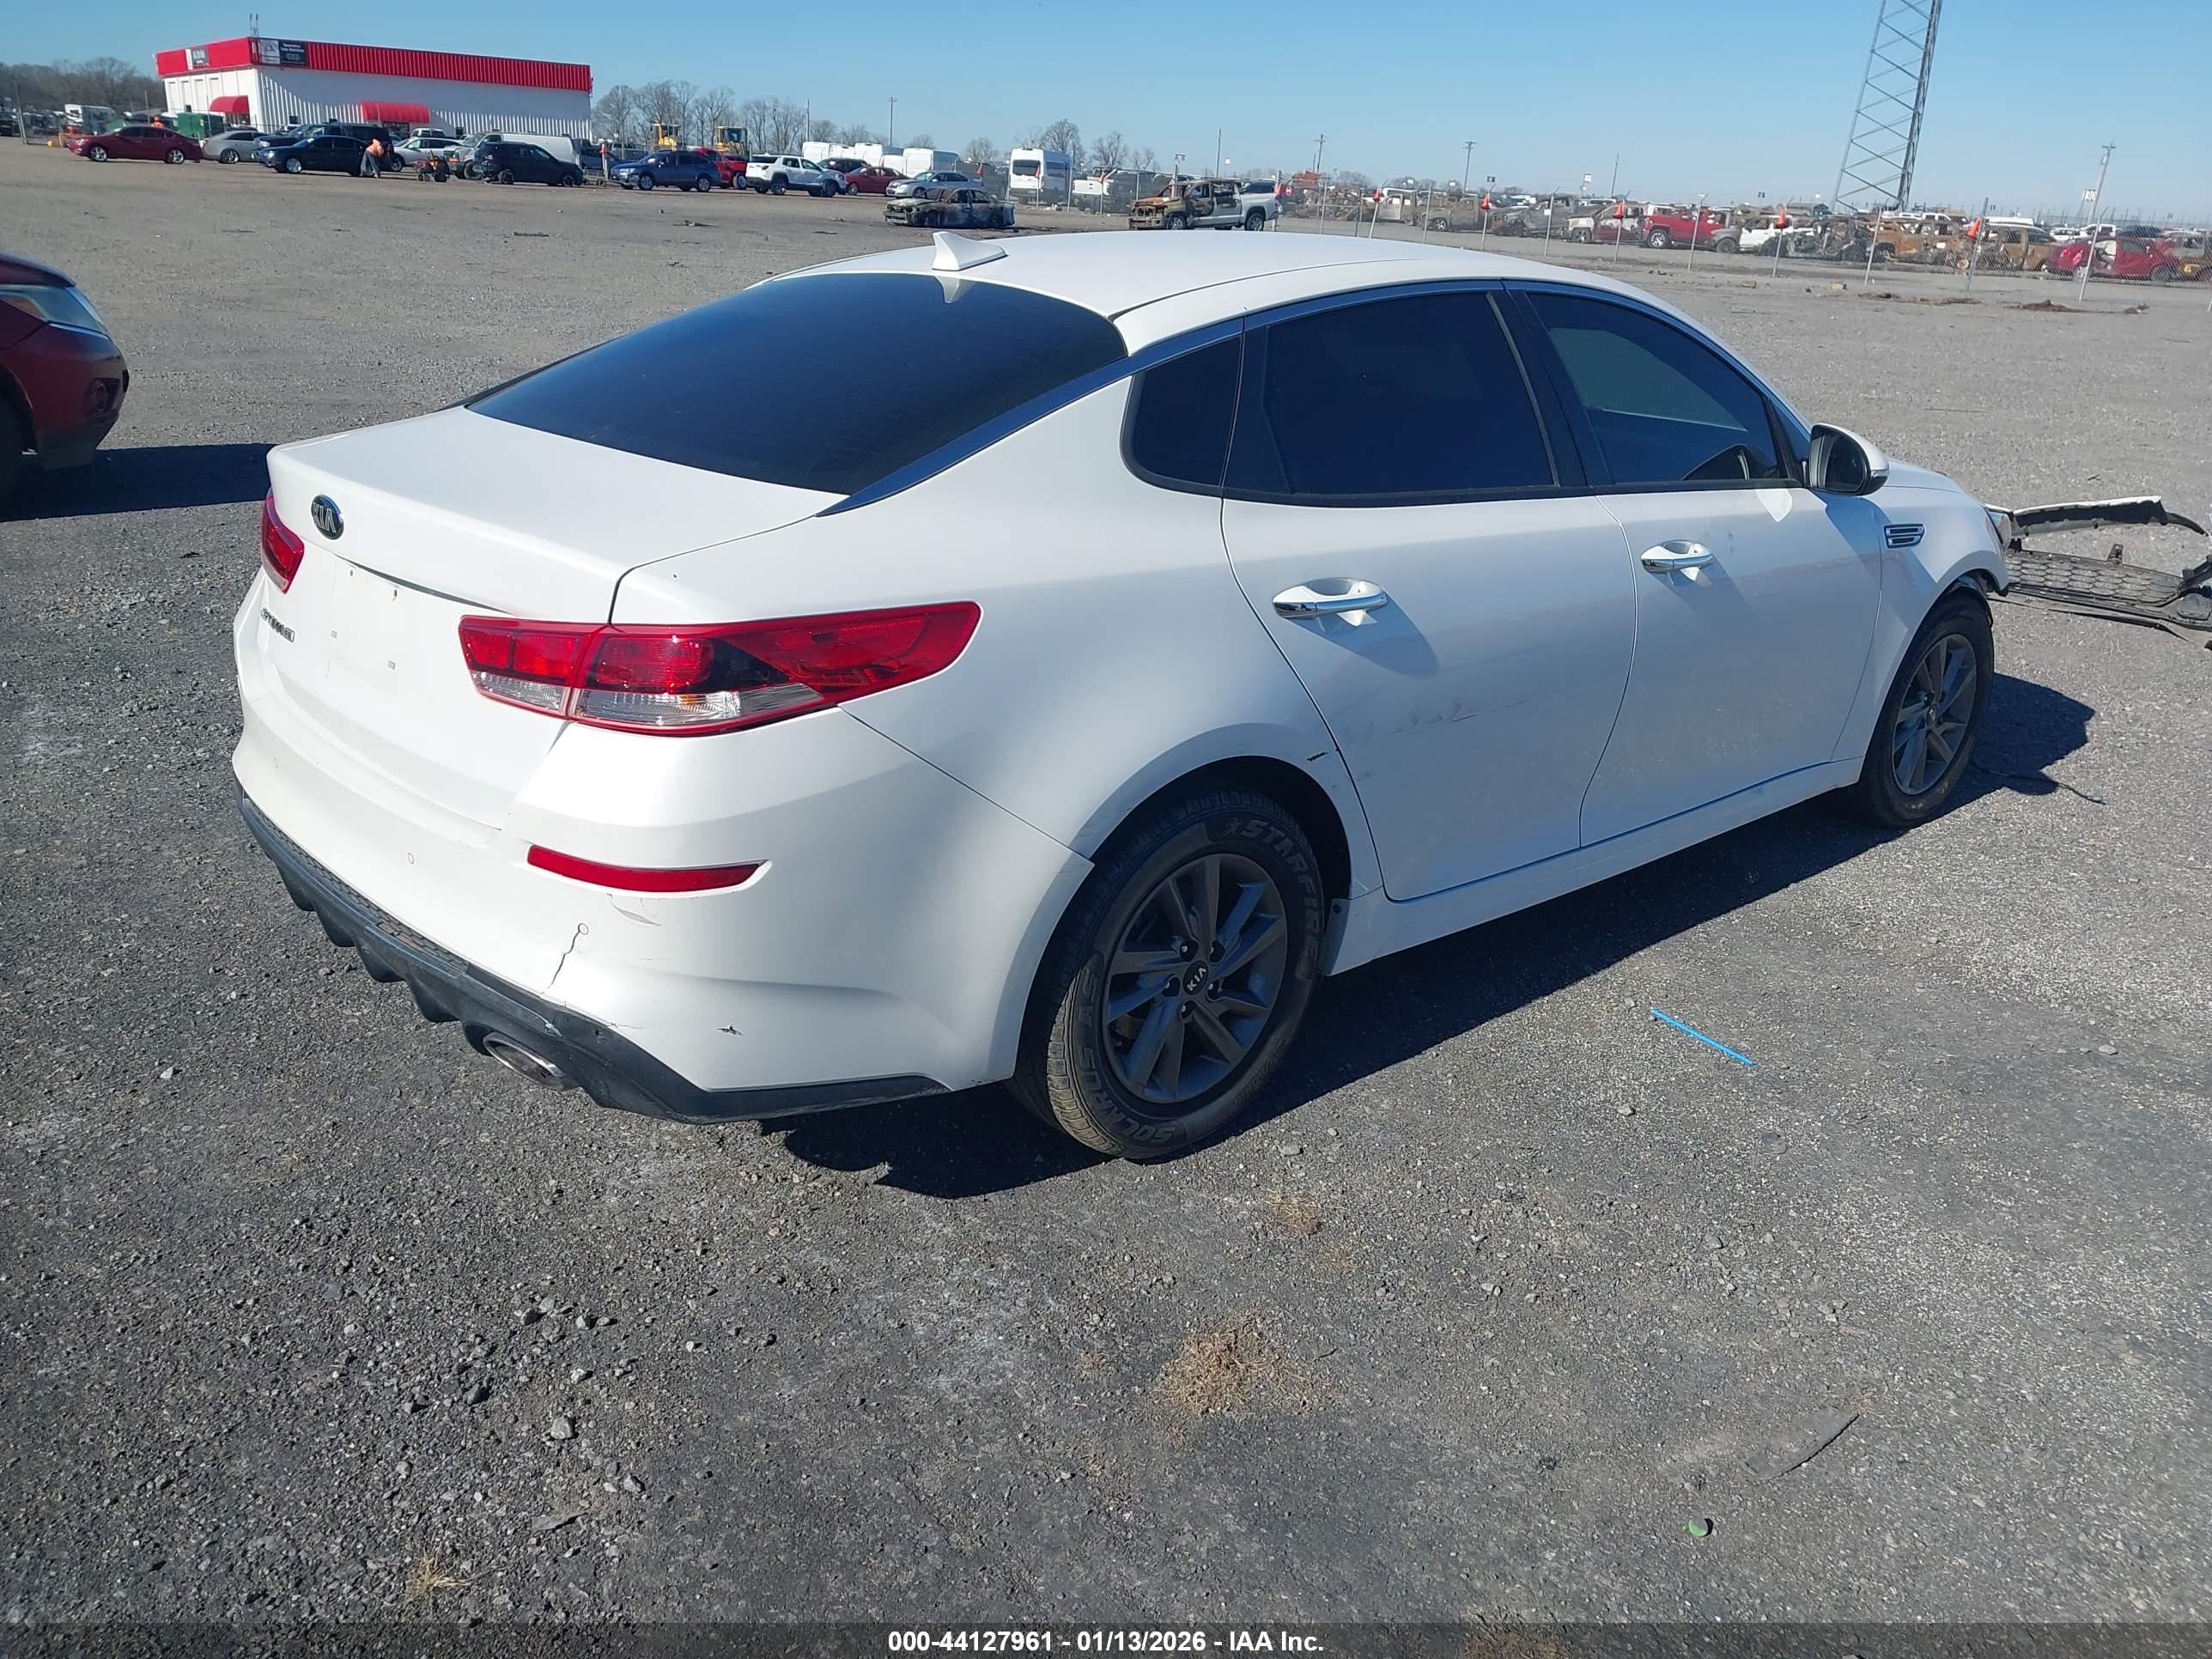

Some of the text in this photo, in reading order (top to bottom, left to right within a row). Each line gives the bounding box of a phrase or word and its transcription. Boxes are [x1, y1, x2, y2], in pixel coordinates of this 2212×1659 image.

[313, 501, 337, 533] KIA
[1239, 819, 1320, 960] STARFIRE
[1187, 967, 1206, 992] KIA
[1078, 1043, 1176, 1145] SOLARUS
